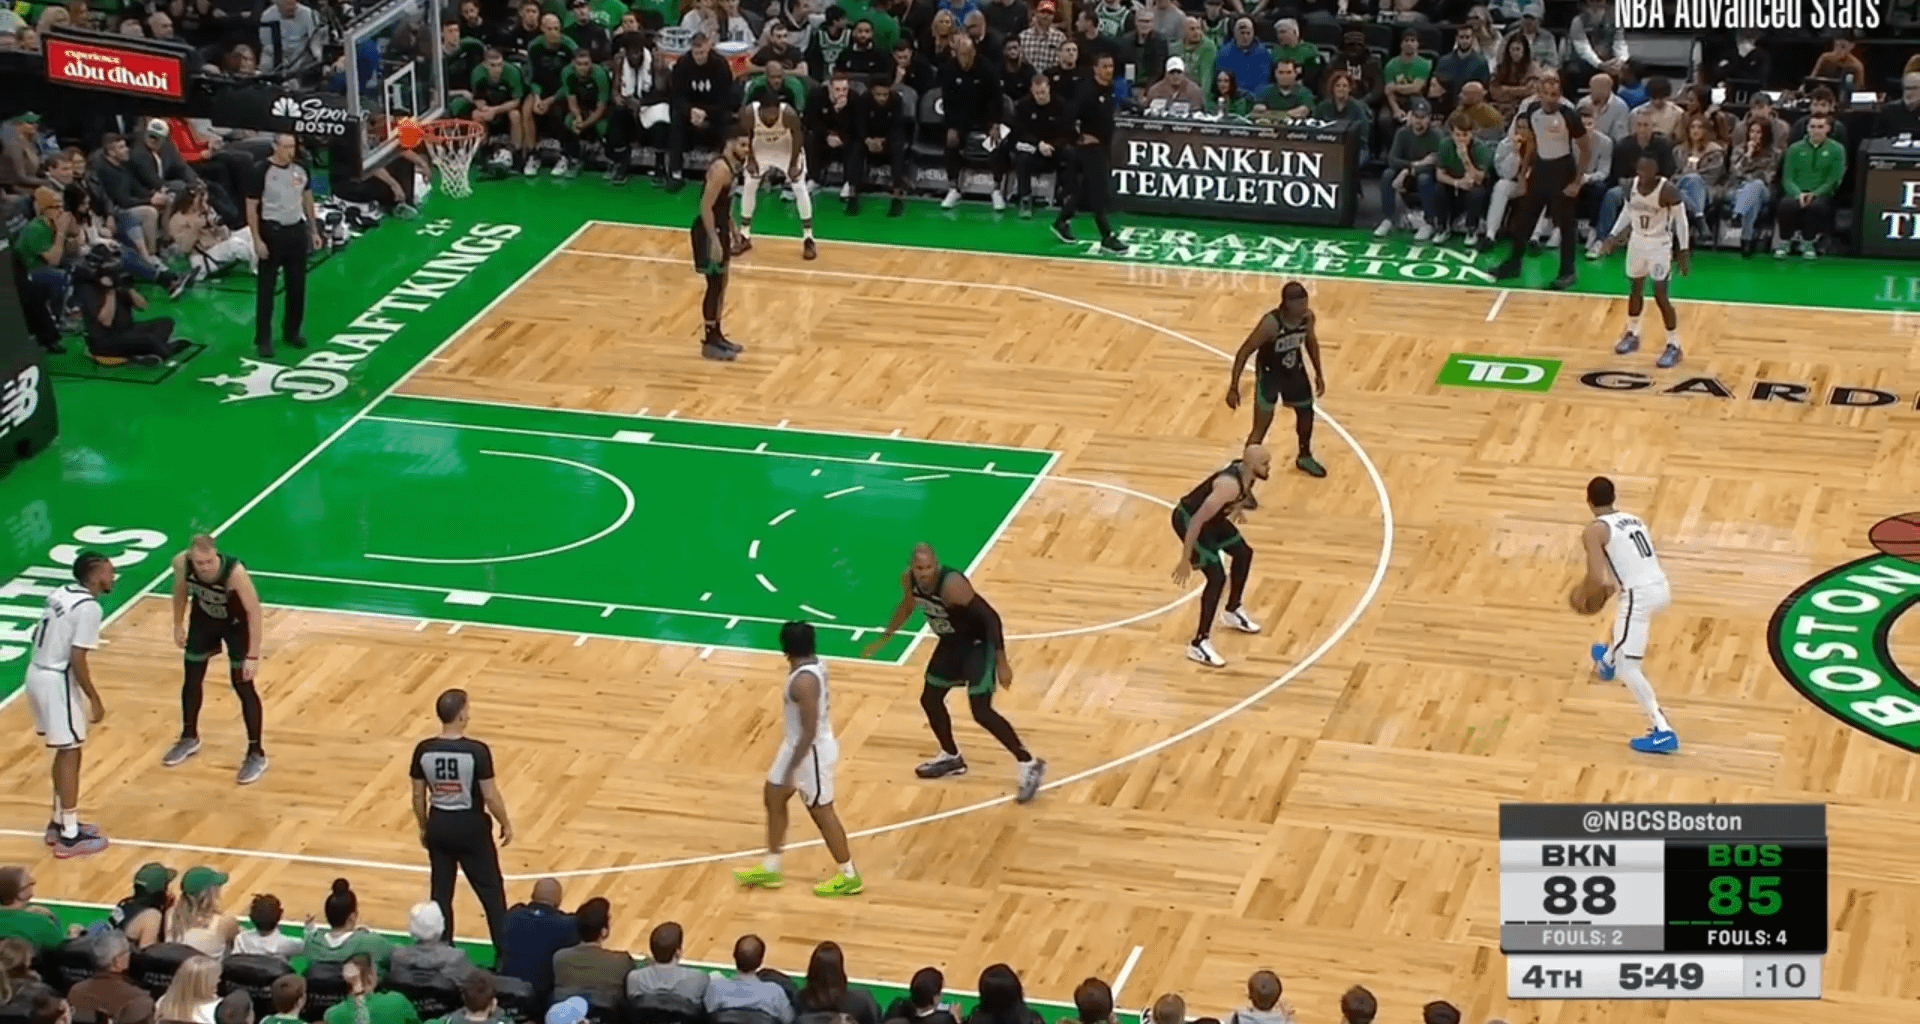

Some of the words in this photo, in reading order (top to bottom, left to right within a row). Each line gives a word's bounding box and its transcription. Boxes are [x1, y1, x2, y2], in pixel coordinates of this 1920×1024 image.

[63, 61, 105, 81] abu
[107, 66, 168, 91] dhabi
[295, 120, 346, 136] BOSTO
[1126, 140, 1324, 178] FRANKLIN
[1111, 168, 1339, 209] TEMPLETON
[1076, 240, 1498, 283] TEMPLETON
[1117, 226, 1478, 265] FRANKLIN
[273, 223, 522, 401] DRAFTKINGS
[1456, 359, 1546, 384] TD
[1577, 370, 1920, 410] GARD
[1629, 530, 1652, 558] 10
[1792, 565, 1920, 727] BOSTON
[435, 757, 460, 780] 29
